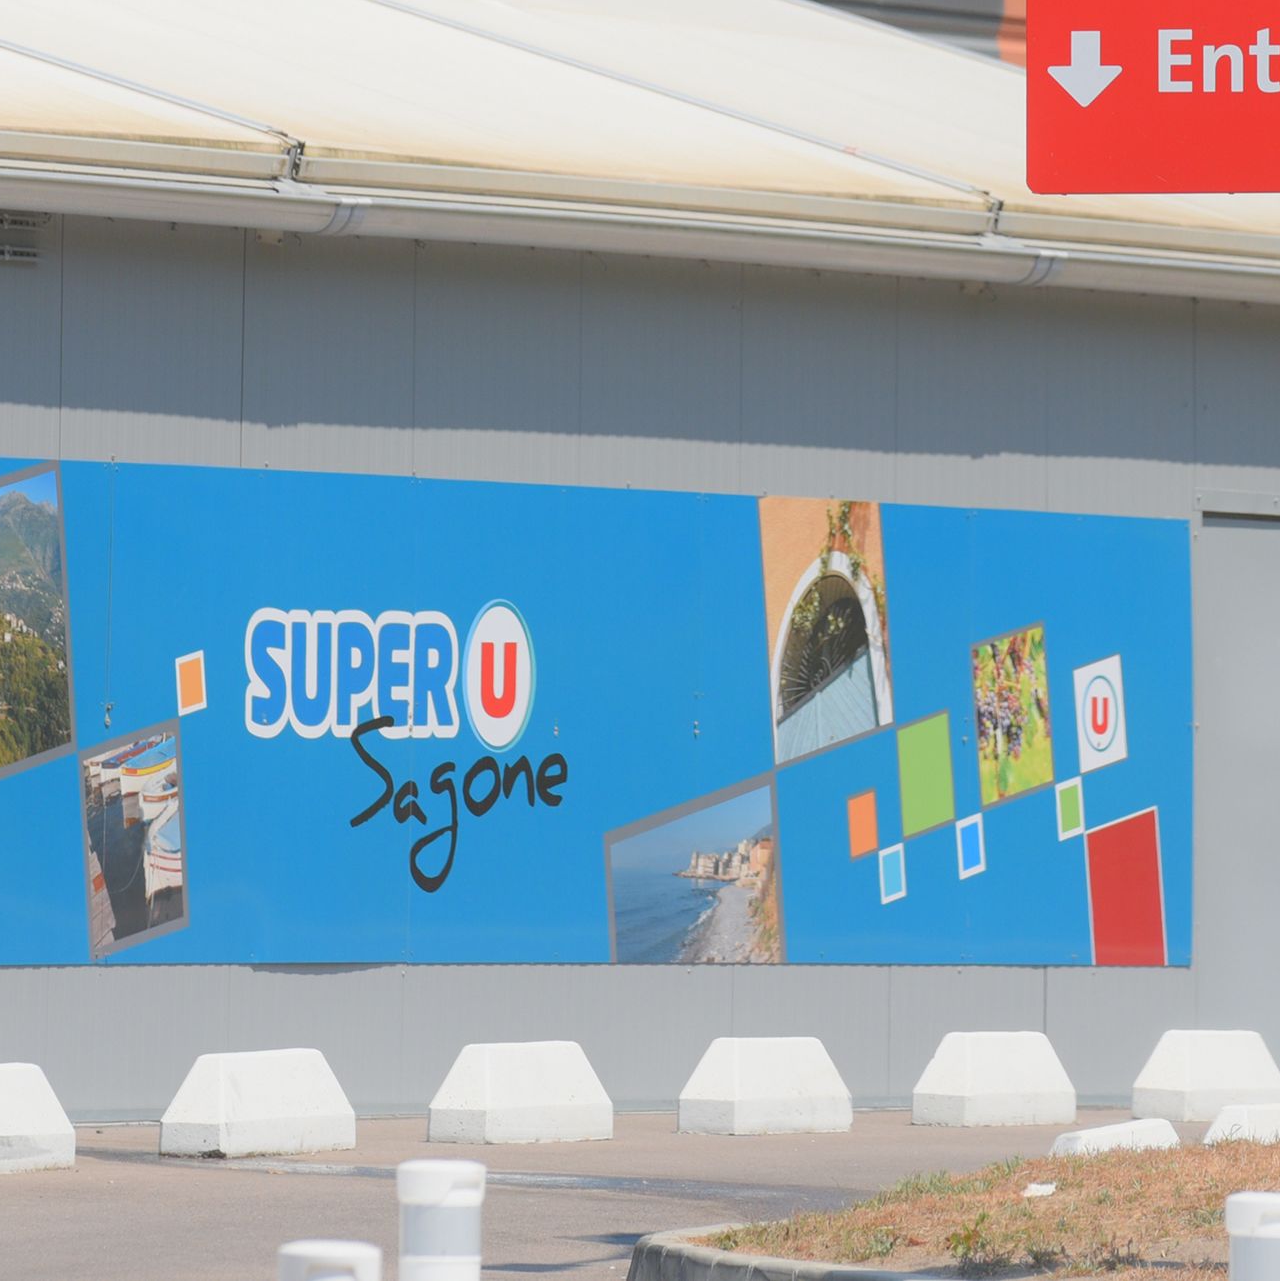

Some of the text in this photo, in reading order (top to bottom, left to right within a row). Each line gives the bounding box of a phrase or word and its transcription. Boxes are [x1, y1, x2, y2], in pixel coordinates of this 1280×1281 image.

[245, 608, 518, 739] SUPER U
[1091, 697, 1109, 735] U
[350, 716, 568, 893] Sagone
